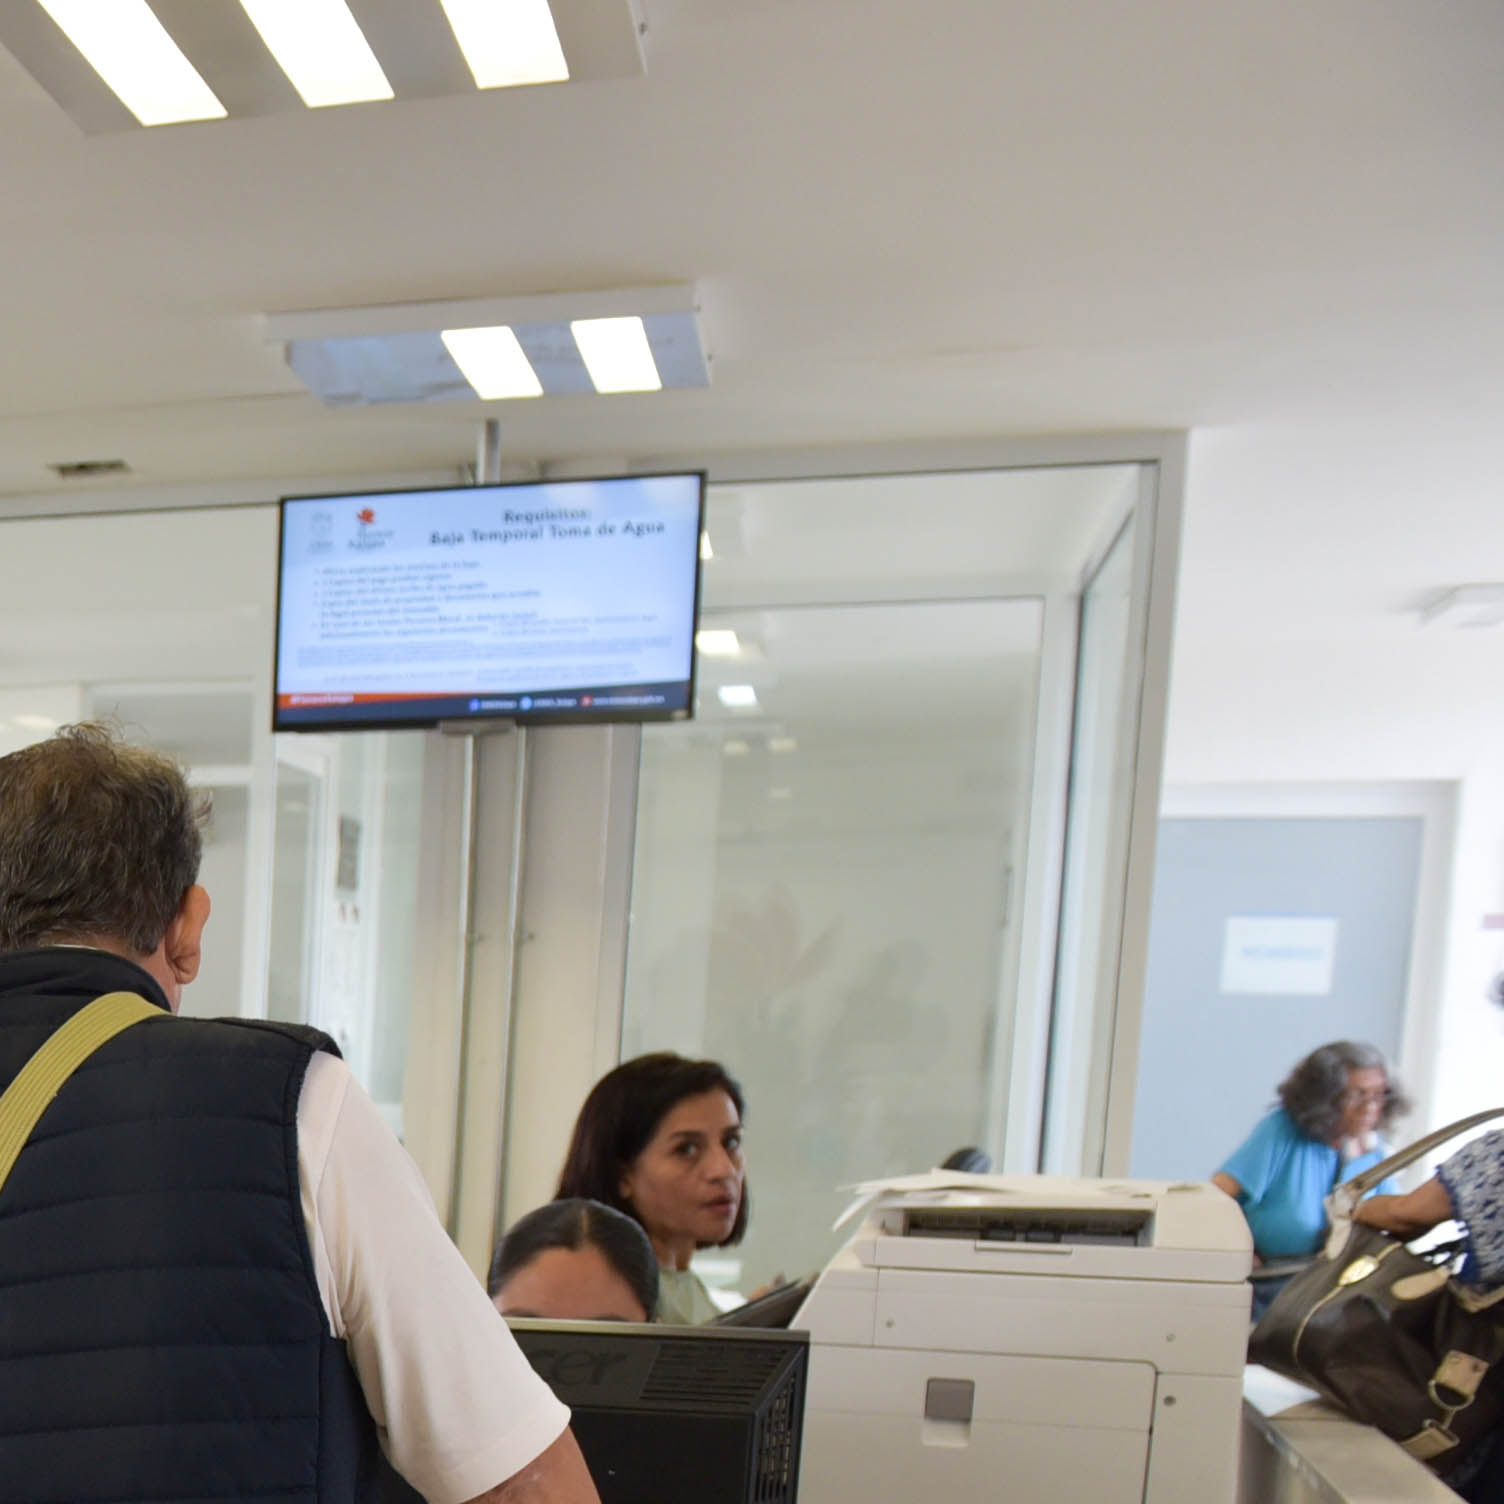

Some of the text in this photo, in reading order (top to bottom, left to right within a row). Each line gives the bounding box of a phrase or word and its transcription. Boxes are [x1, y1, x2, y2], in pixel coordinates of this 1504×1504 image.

[430, 520, 666, 546] Baja Temporal Toma de Agua
